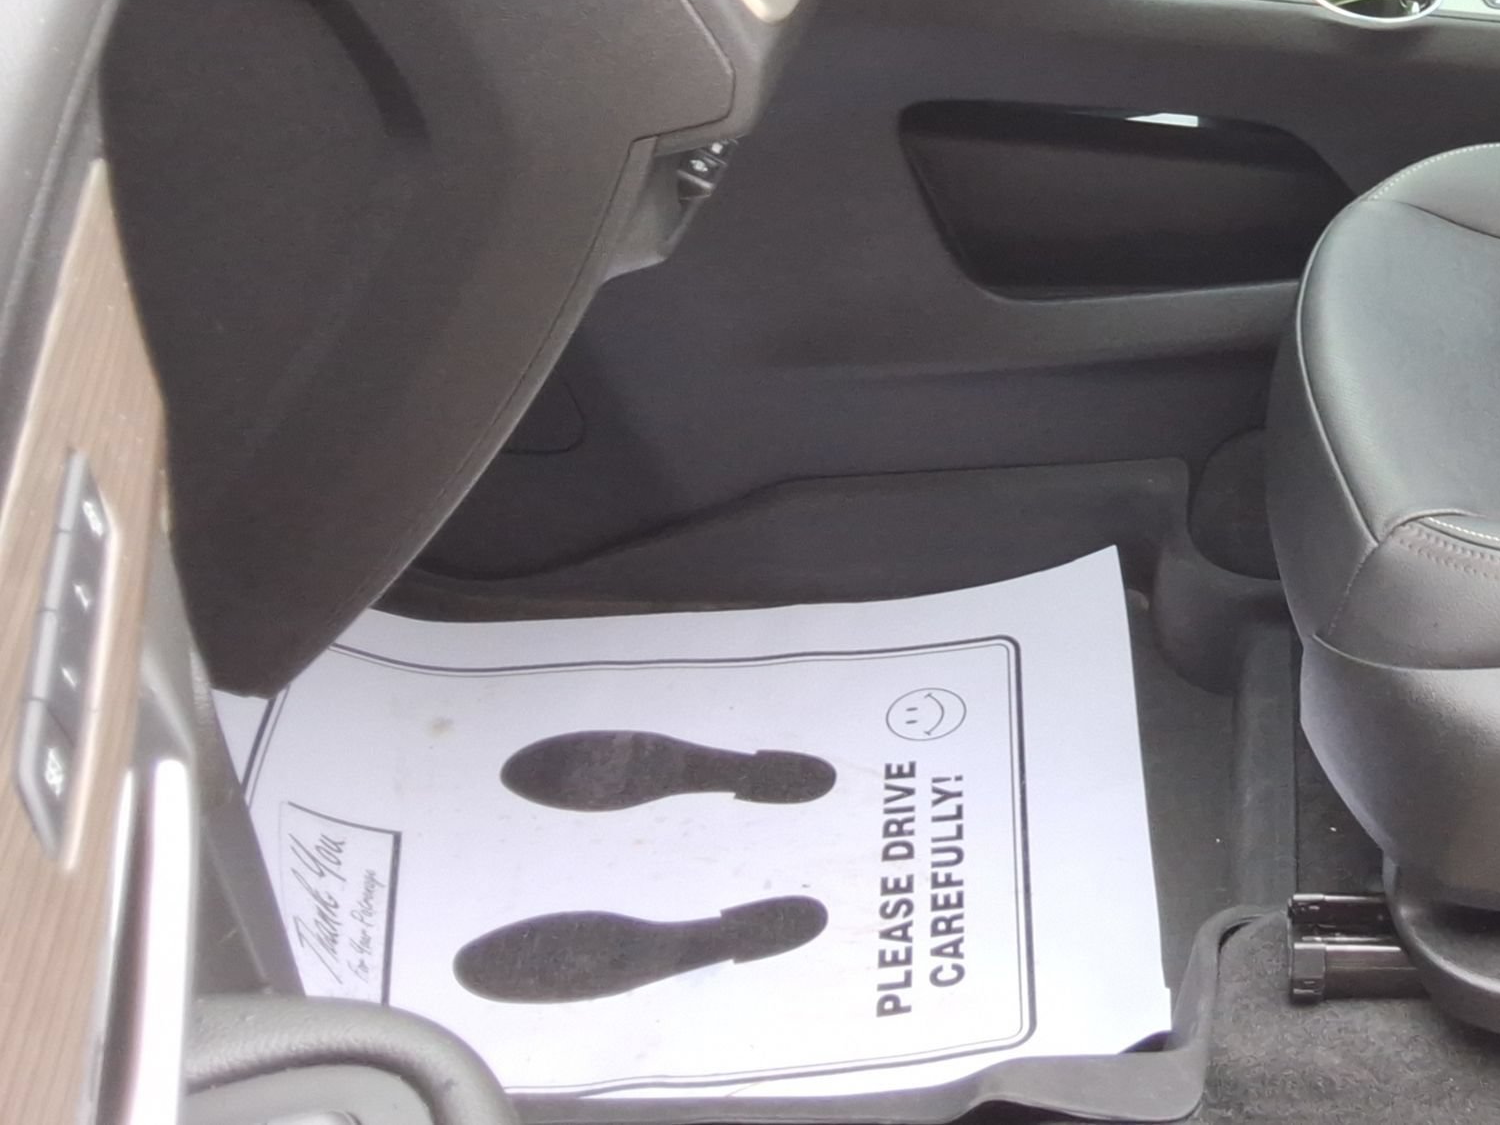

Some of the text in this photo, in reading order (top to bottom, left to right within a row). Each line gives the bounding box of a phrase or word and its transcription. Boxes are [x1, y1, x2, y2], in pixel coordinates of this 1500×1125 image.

[288, 832, 347, 985] Thank You
[876, 761, 917, 1018] PLEASE DRIVE
[929, 775, 966, 988] CAREFULLY!
